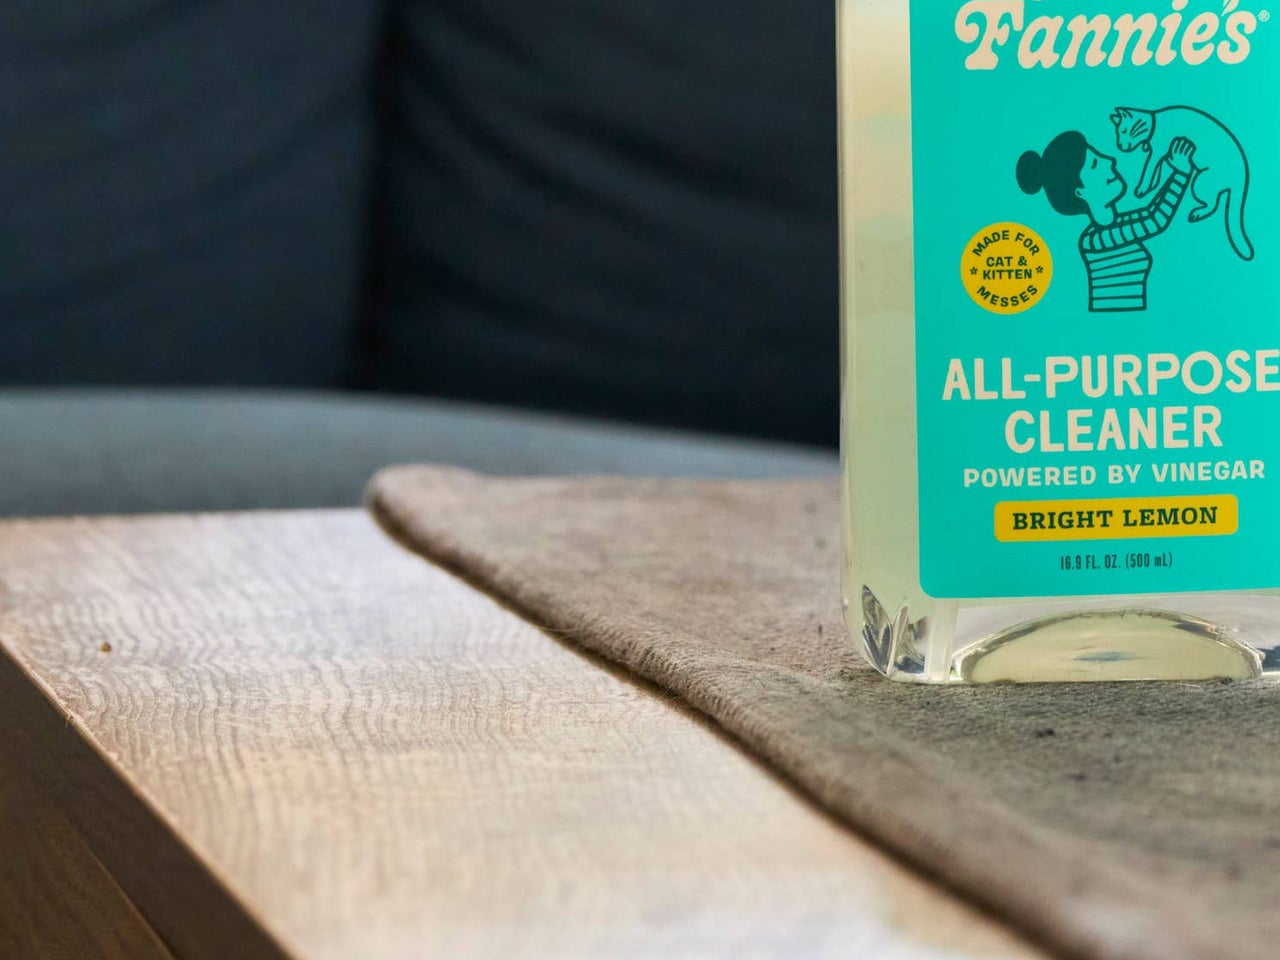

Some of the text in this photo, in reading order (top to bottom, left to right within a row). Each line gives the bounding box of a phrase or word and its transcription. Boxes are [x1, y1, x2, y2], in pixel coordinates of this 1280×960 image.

[972, 230, 1040, 257] MADE FOR
[986, 255, 1028, 267] CAT &
[982, 269, 1033, 280] KITTEN
[976, 284, 1038, 307] MESSES
[941, 349, 1280, 401] ALL-PURPOSE
[1004, 405, 1223, 454] CLEANER
[963, 459, 1266, 488] POWERED BY VINEGAR
[1012, 506, 1218, 531] BRIGHT LEMON
[1060, 551, 1174, 571] 16.9 FL. OZ. (500 mL)
